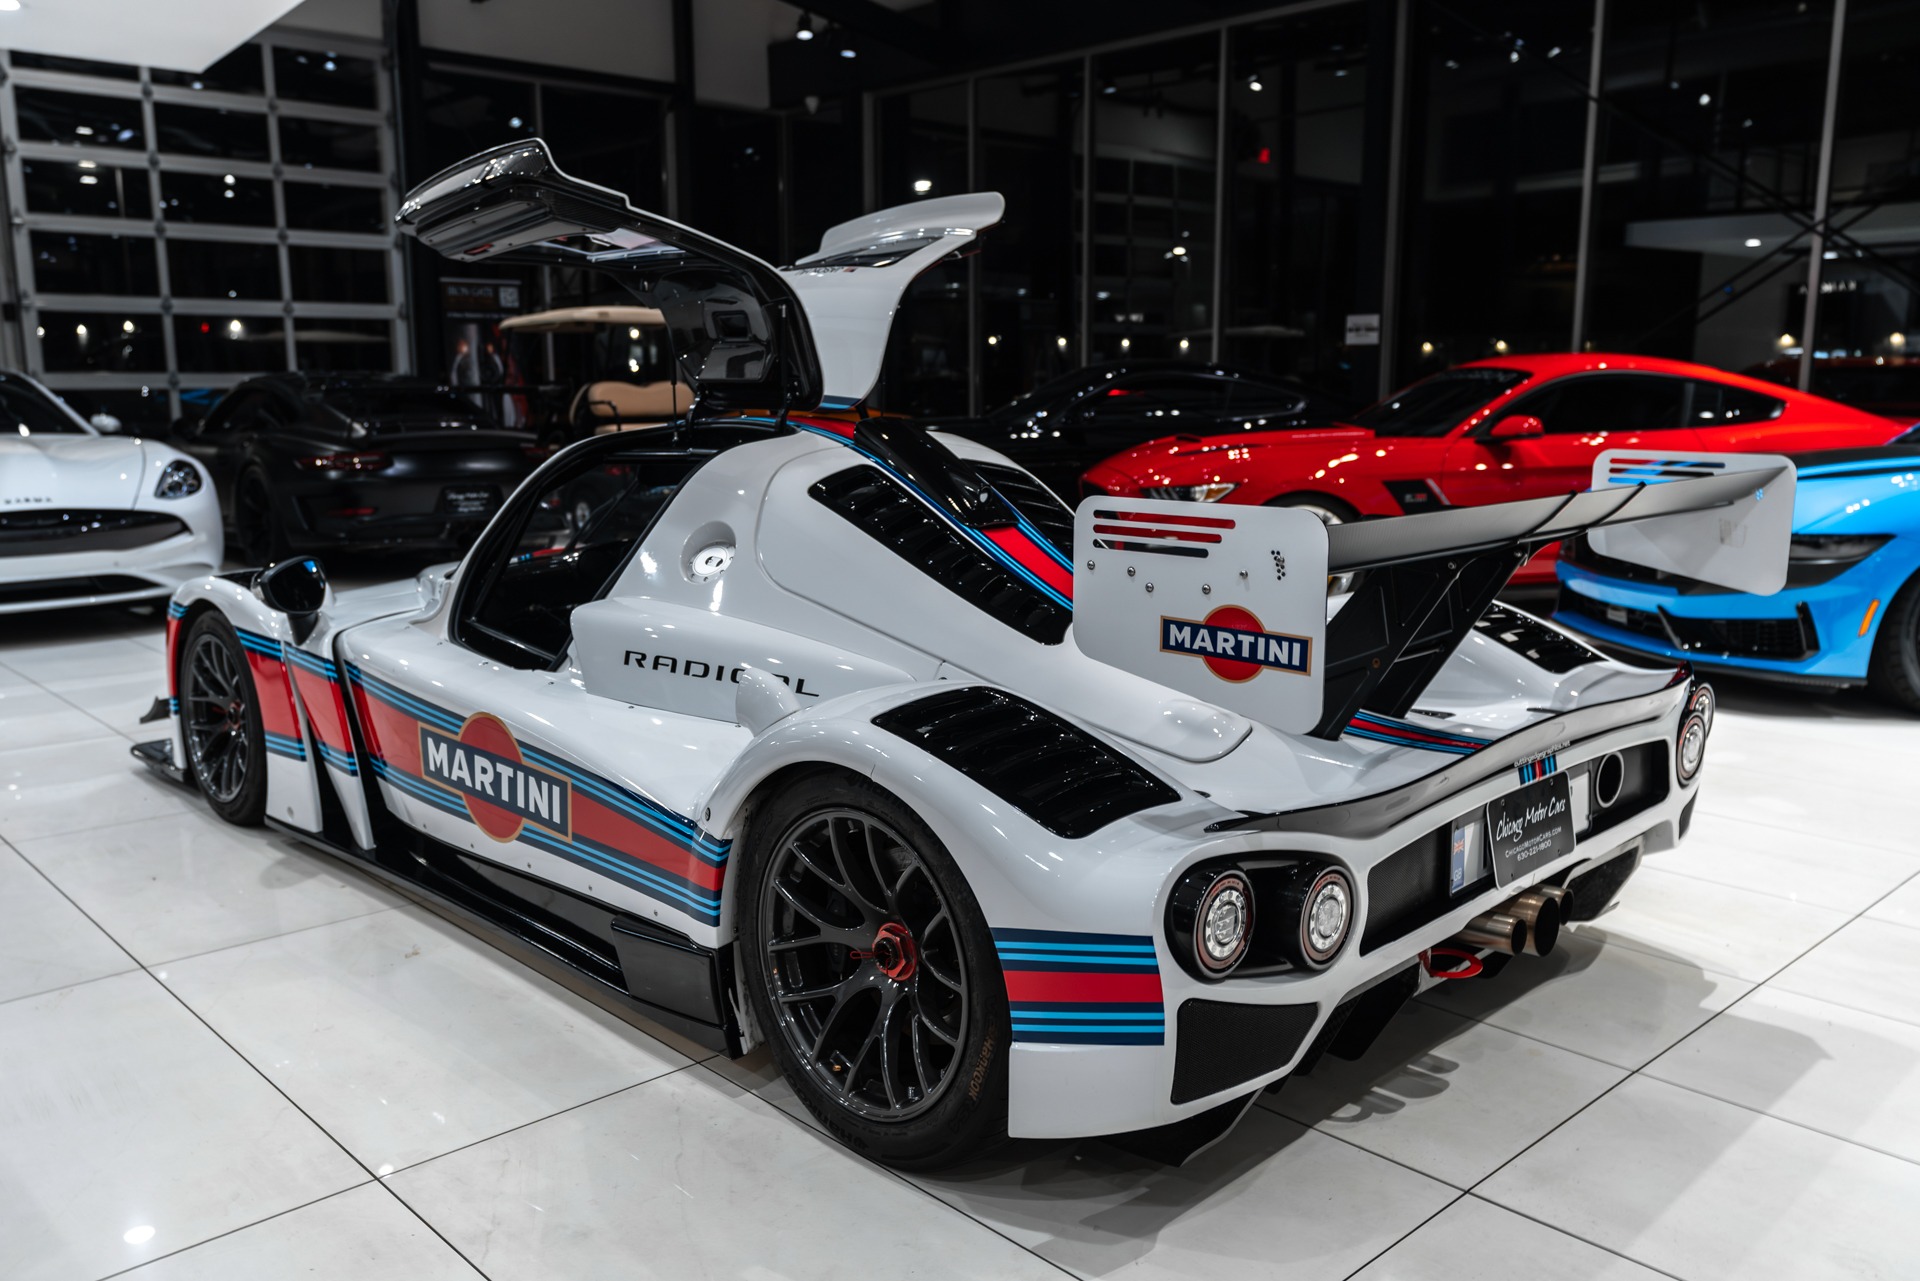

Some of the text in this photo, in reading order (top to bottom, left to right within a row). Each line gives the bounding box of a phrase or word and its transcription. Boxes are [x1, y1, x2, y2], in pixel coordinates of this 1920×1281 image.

[1169, 623, 1301, 667] MARTINI
[426, 736, 561, 825] MARTINI
[1496, 796, 1566, 842] Chicago Motor Cars
[1517, 839, 1552, 861] 630-221-1800
